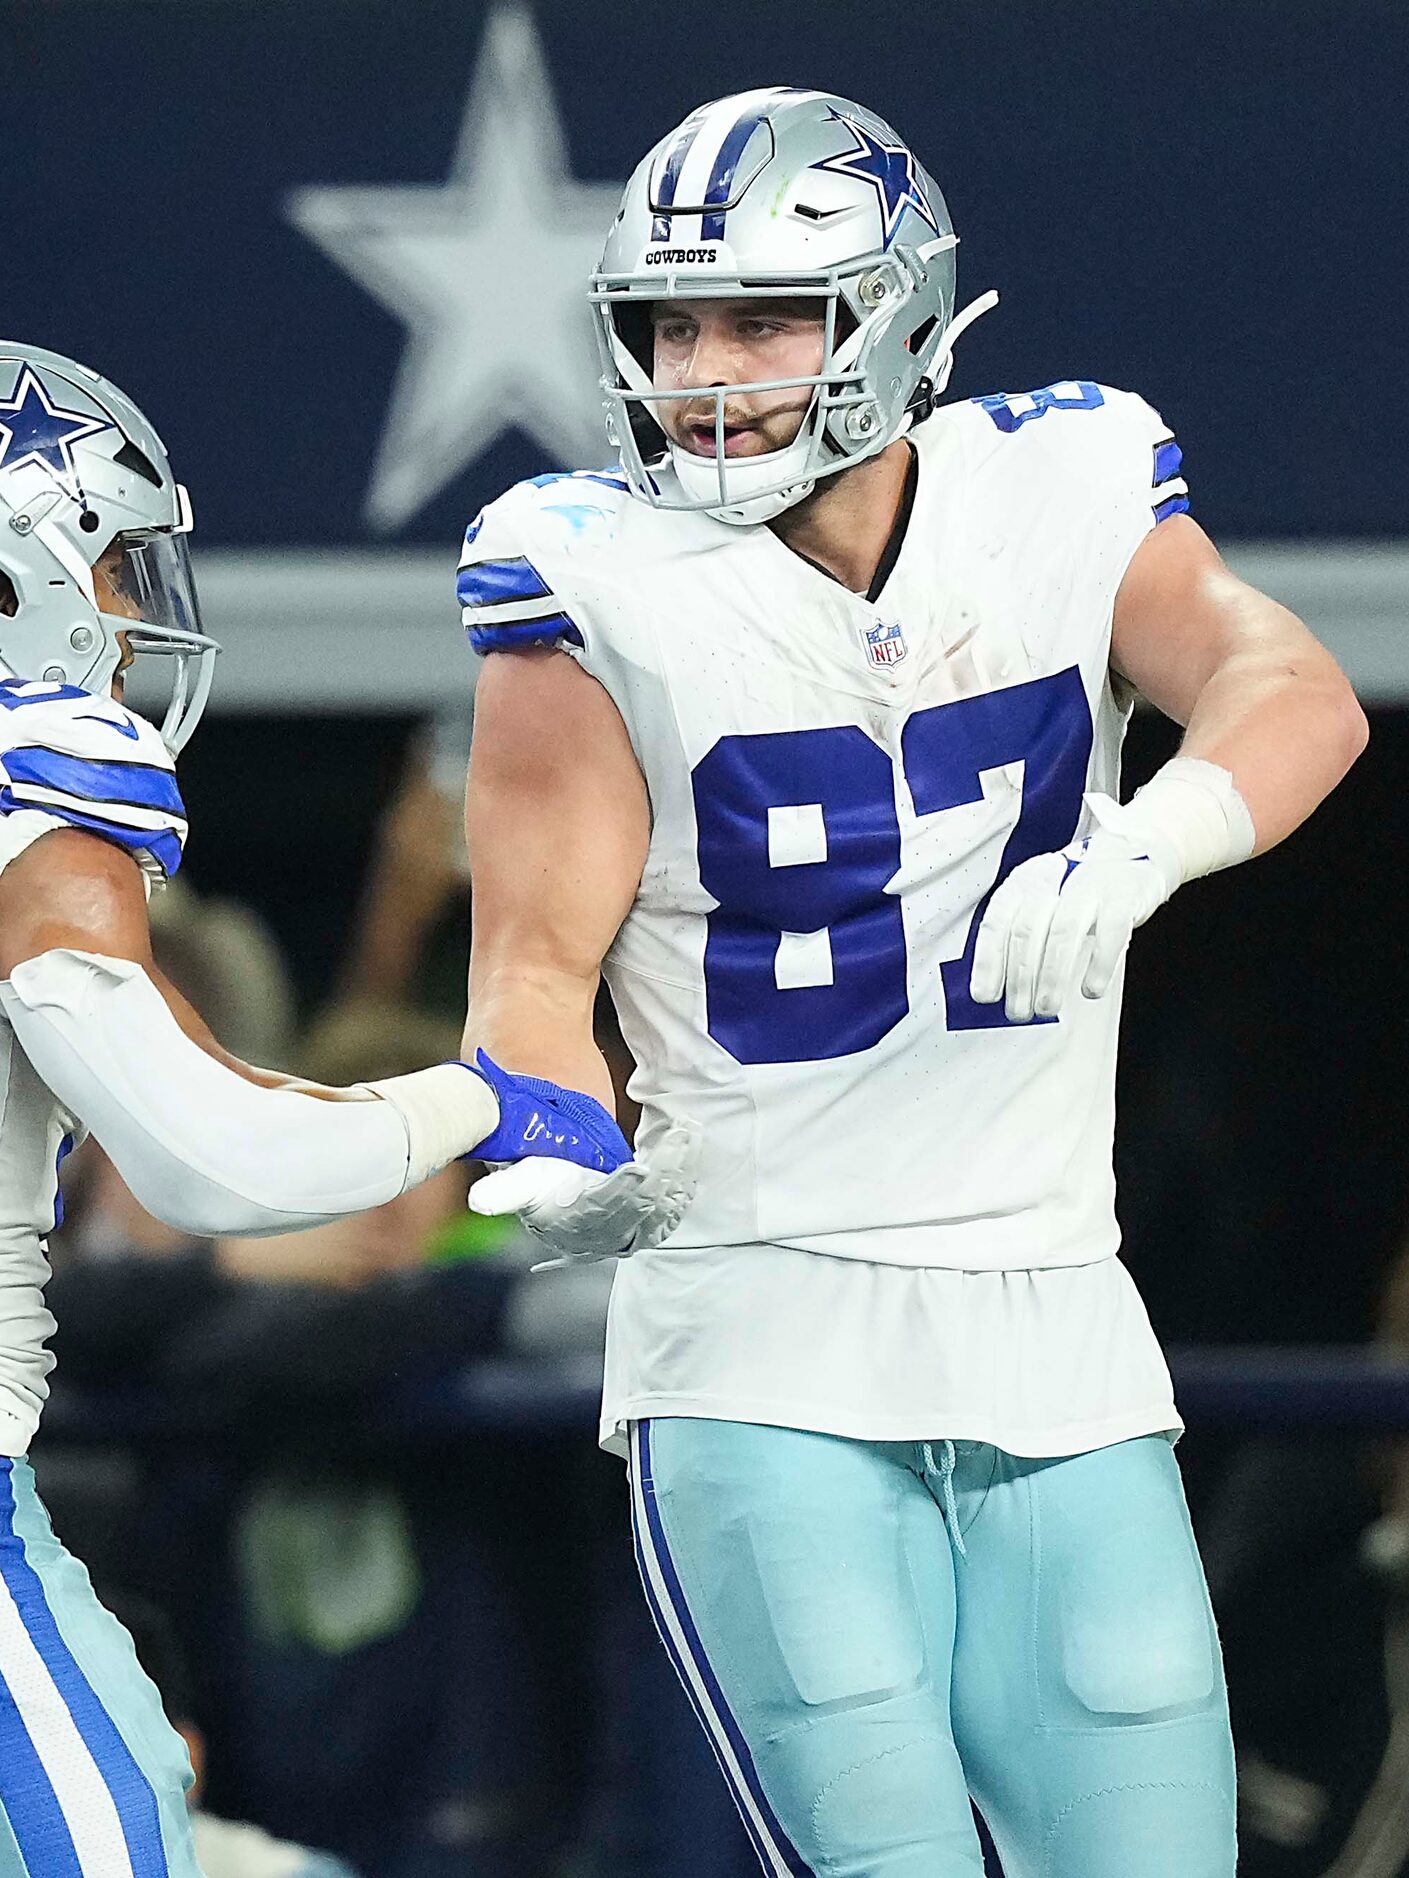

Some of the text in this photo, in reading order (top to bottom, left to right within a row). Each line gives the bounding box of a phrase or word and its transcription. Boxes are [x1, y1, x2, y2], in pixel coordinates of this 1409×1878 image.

[645, 249, 717, 265] COWBOYS
[872, 640, 903, 662] NFL
[691, 664, 1094, 1066] 87
